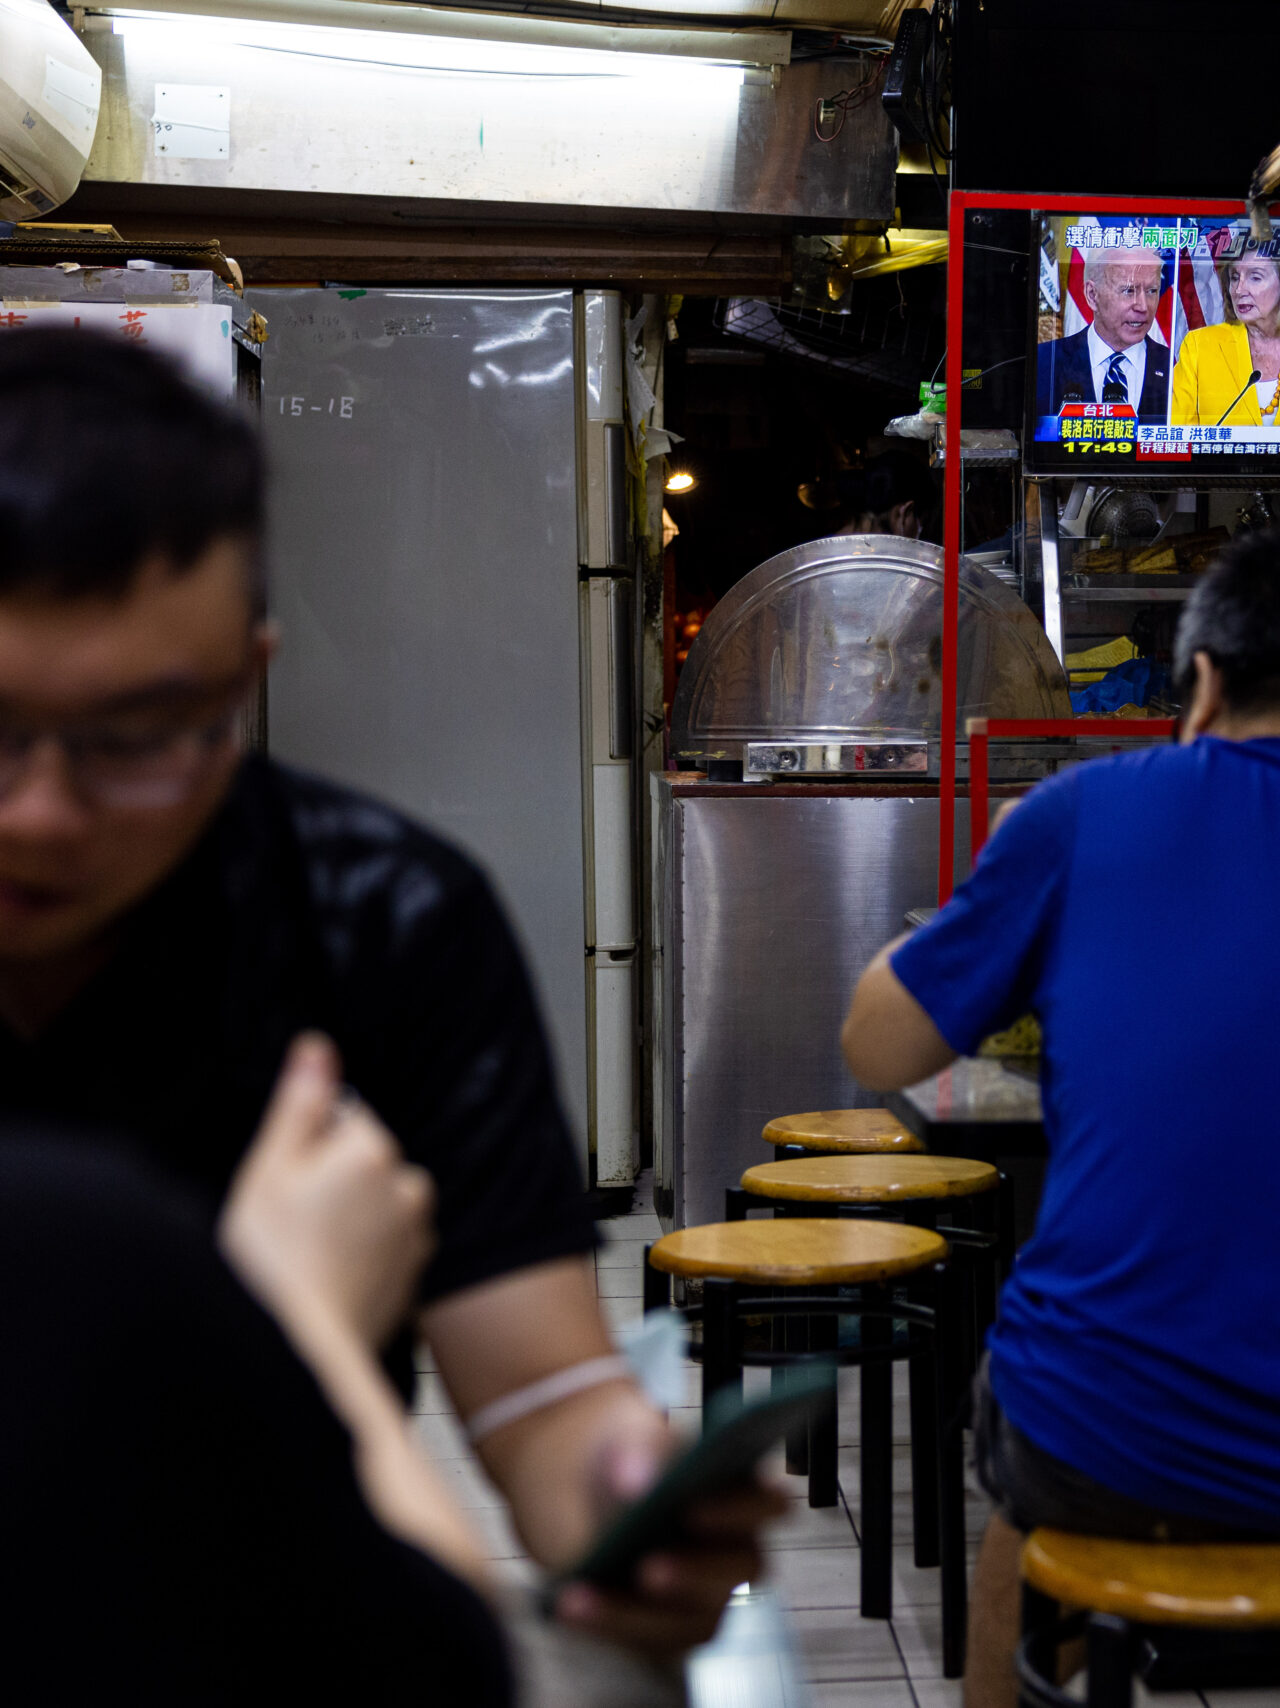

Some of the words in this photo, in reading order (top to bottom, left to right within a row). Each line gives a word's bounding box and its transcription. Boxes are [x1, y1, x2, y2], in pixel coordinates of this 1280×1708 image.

[1066, 226, 1198, 249] 選情衝擊兩面刃
[1084, 404, 1114, 416] 台北
[1061, 419, 1135, 439] 裴洛西行程敲定
[1141, 427, 1184, 441] 李品誼
[1189, 427, 1232, 441] 洪復華
[1064, 442, 1132, 453] 17:49
[1140, 442, 1189, 454] 行程擬延
